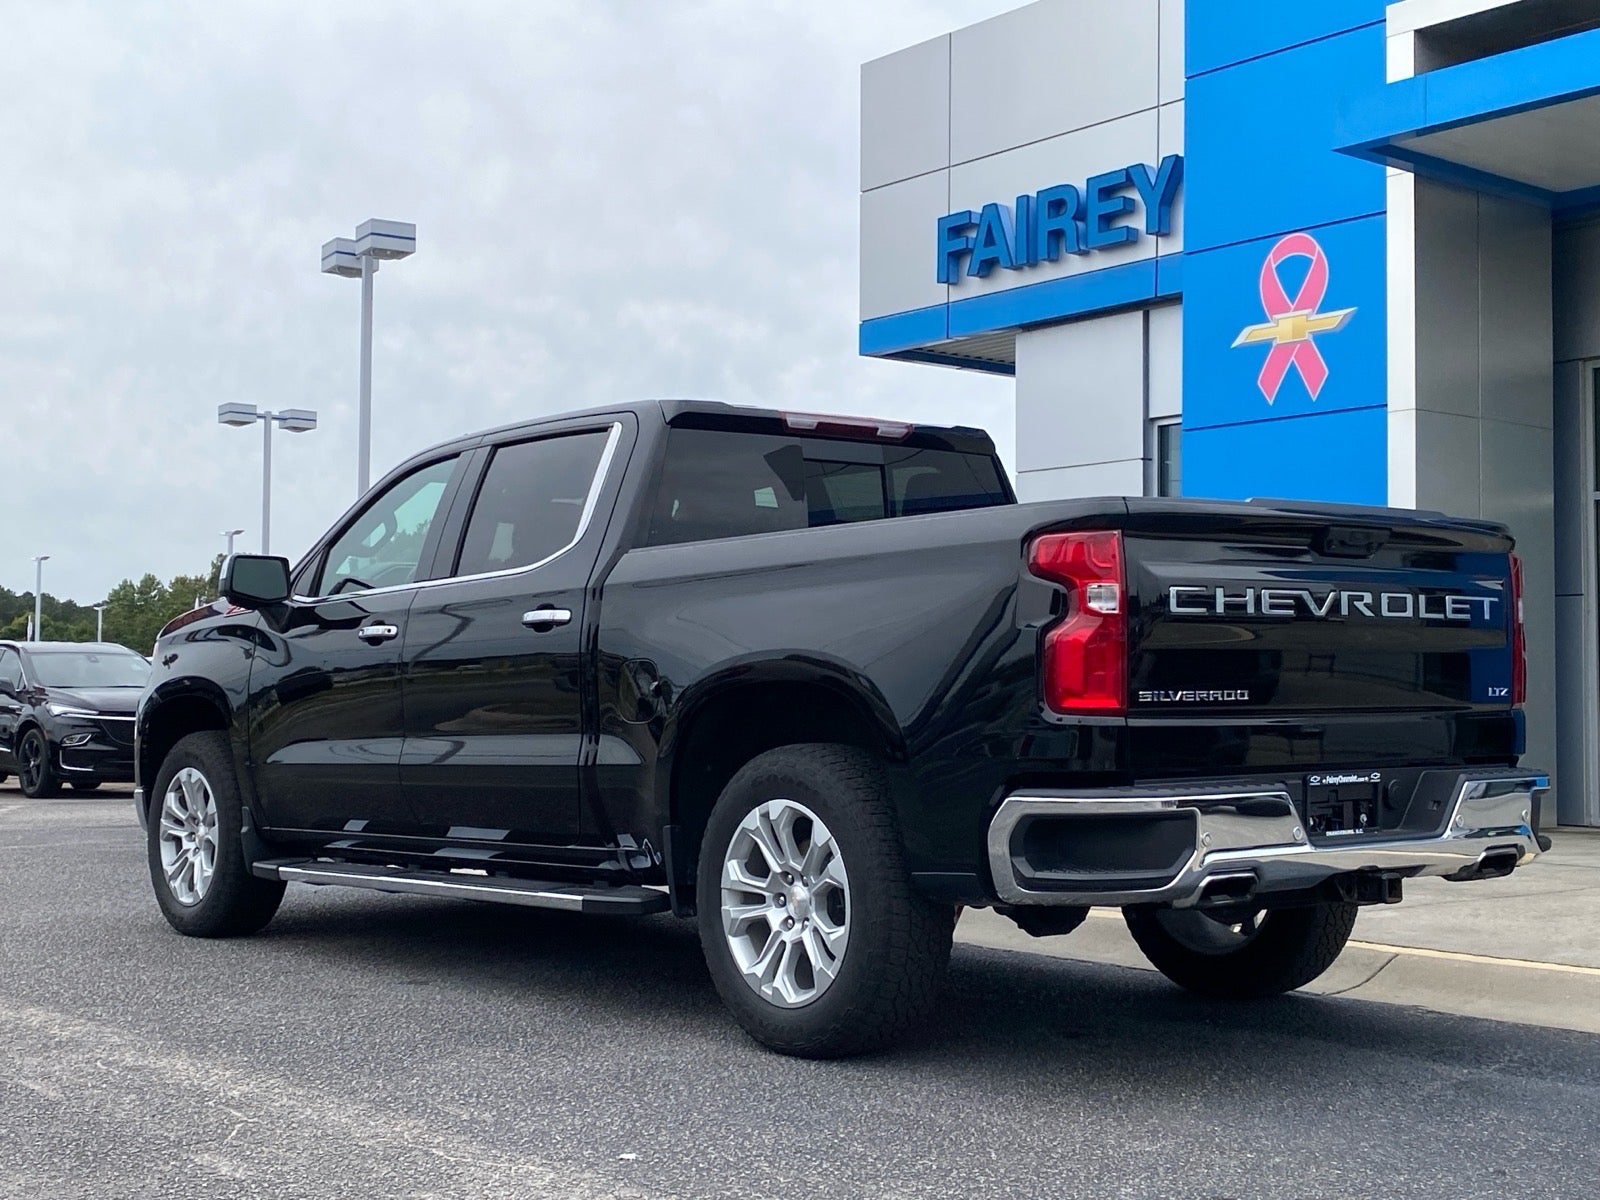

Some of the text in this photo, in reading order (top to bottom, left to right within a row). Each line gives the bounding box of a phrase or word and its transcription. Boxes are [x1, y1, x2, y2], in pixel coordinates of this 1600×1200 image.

[937, 154, 1184, 284] FAIREY
[1168, 586, 1499, 621] CHEVROLET
[1138, 690, 1249, 702] SILVERADO
[1488, 687, 1509, 697] LTZ
